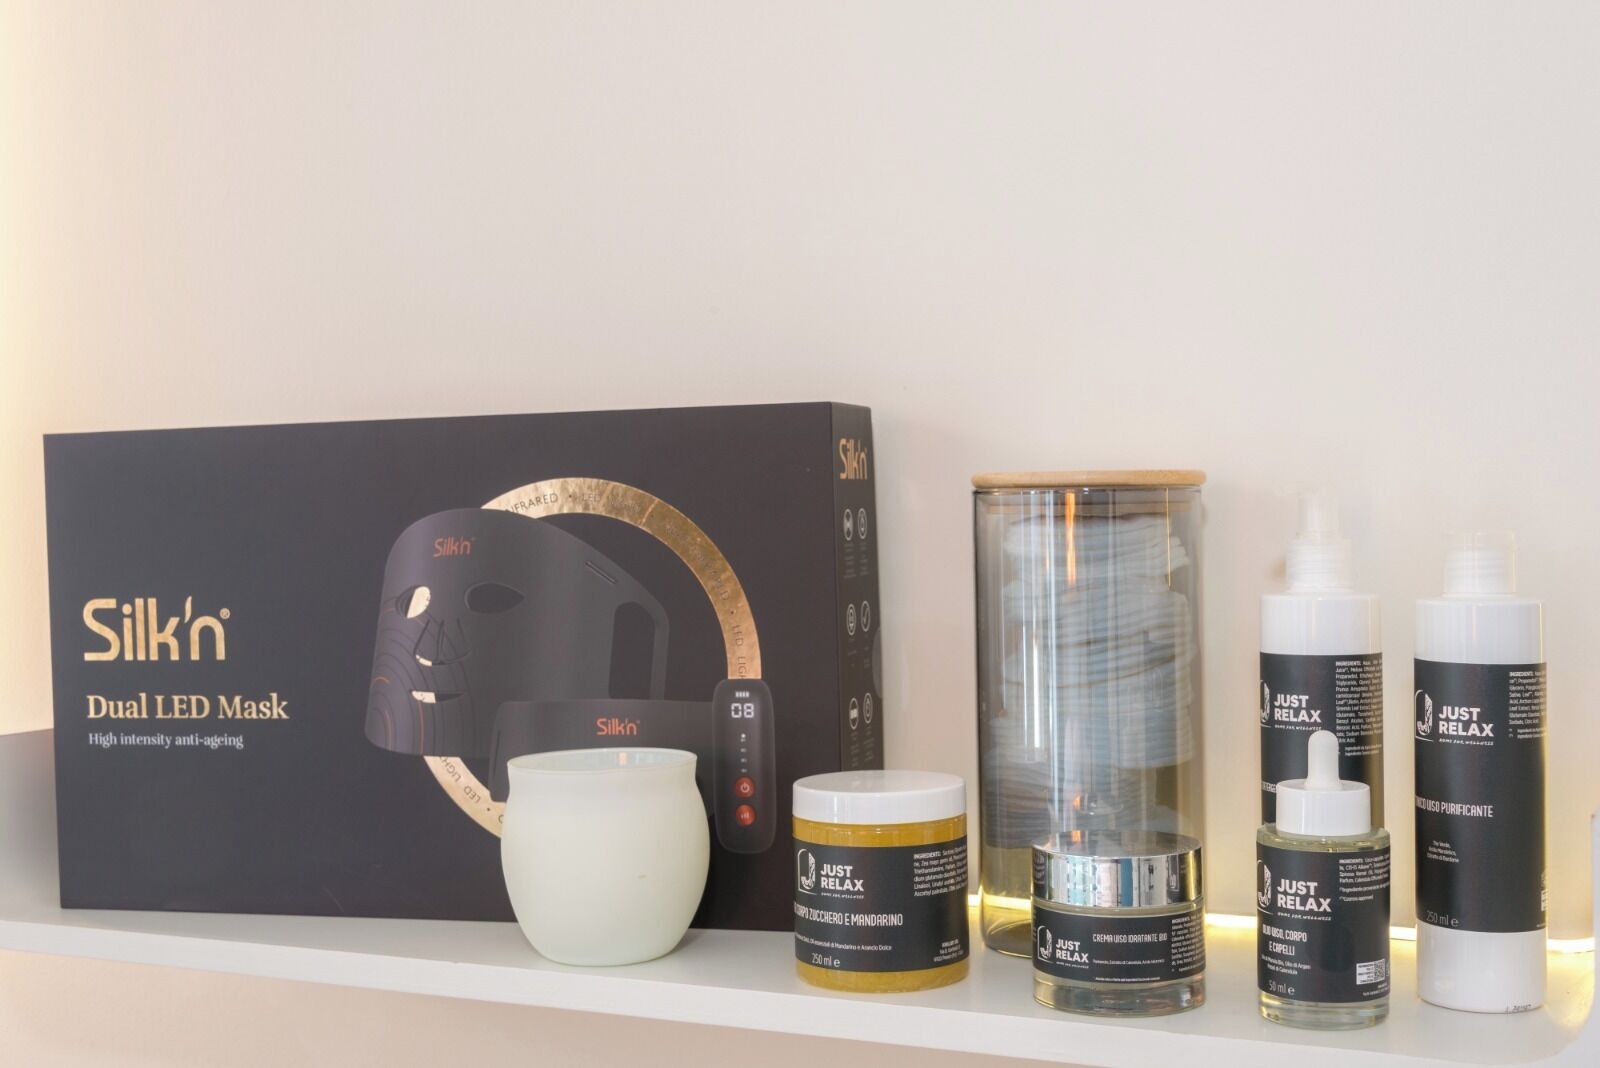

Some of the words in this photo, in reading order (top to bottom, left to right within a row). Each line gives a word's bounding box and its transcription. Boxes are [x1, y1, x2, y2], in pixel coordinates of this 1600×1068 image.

[87, 692, 150, 719] Dual
[154, 694, 212, 719] LED
[218, 692, 290, 719] Mask
[1274, 694, 1309, 708] JUST
[731, 703, 755, 718] 08
[1274, 707, 1322, 723] RELAX
[1438, 706, 1481, 721] JUST
[1438, 720, 1494, 737] RELAX
[88, 733, 117, 748] High
[119, 733, 173, 749] intensity
[174, 734, 245, 750] anti-ageing
[1441, 802, 1494, 818] PURIFICANTE
[820, 863, 854, 877] JUST
[820, 877, 865, 891] RELAX
[1276, 878, 1318, 896] JUST
[1277, 893, 1333, 912] RELAX
[809, 908, 843, 925] ZUCCHERO
[845, 913, 850, 926] E
[851, 913, 904, 926] MANDARINO
[1426, 911, 1438, 923] 250
[1439, 914, 1449, 926] ml
[1092, 933, 1113, 943] CREMA
[1285, 929, 1308, 943] CORPO
[1055, 938, 1081, 951] JUST
[1268, 940, 1273, 951] E
[1273, 942, 1295, 956] CAPELLI
[811, 952, 823, 965] 250
[823, 955, 832, 966] ml
[1055, 949, 1089, 963] RELAX
[1268, 979, 1277, 992] 50
[1277, 983, 1287, 994] ml
